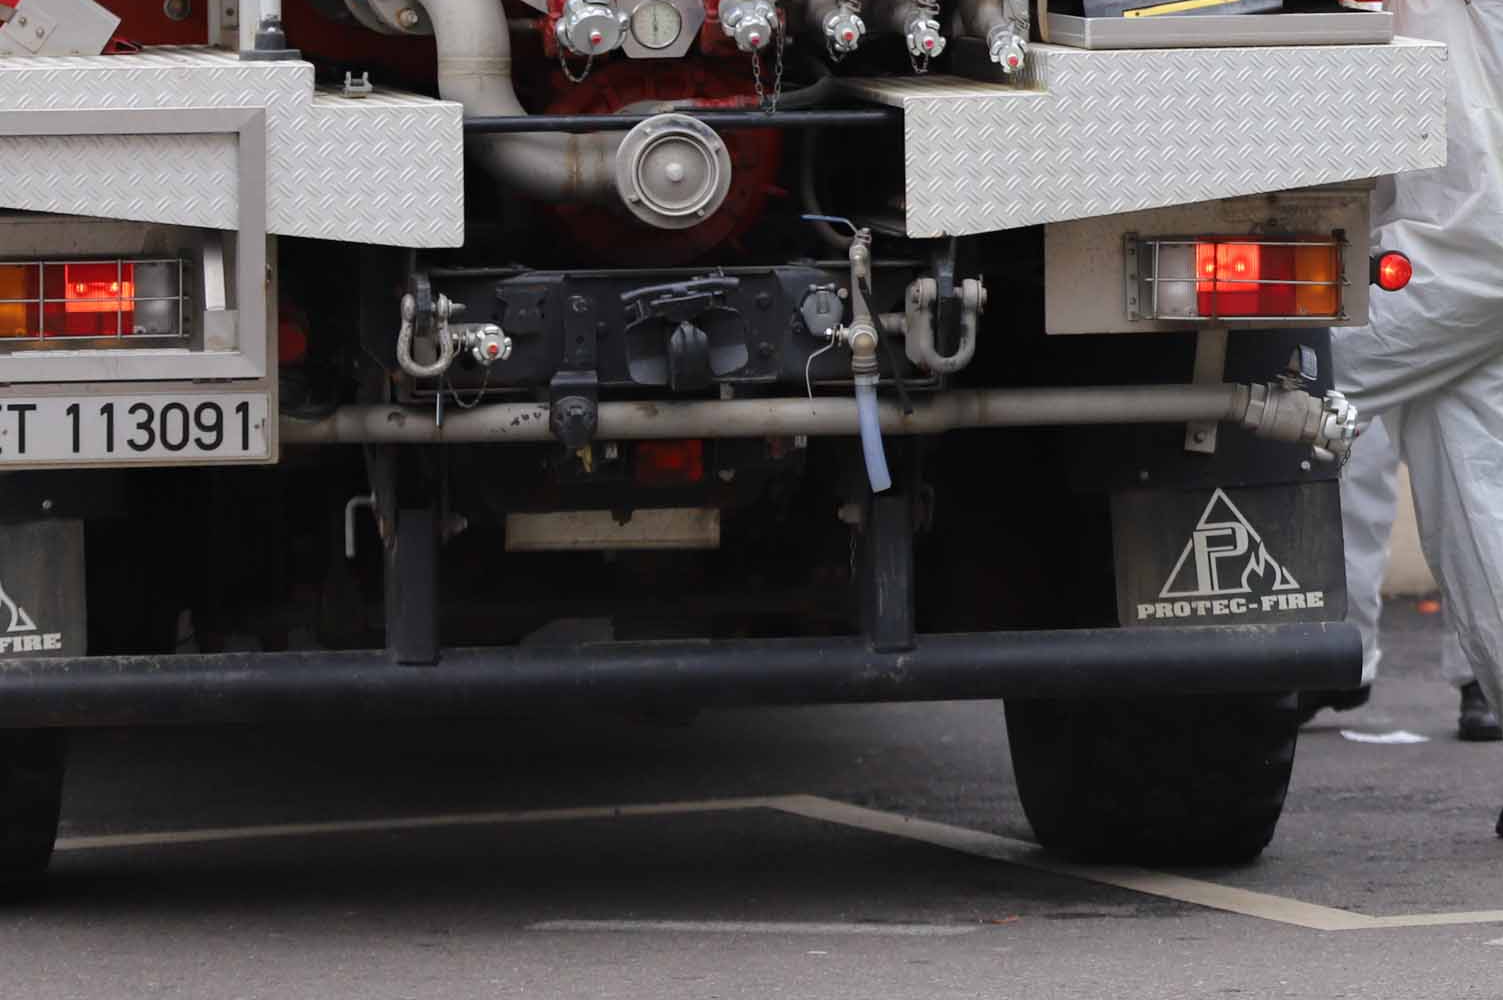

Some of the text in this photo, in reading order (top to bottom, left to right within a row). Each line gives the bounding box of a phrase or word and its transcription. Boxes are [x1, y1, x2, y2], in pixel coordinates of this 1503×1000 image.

[0, 401, 250, 454] T 113091
[1137, 591, 1325, 620] PROTEC-FIRE
